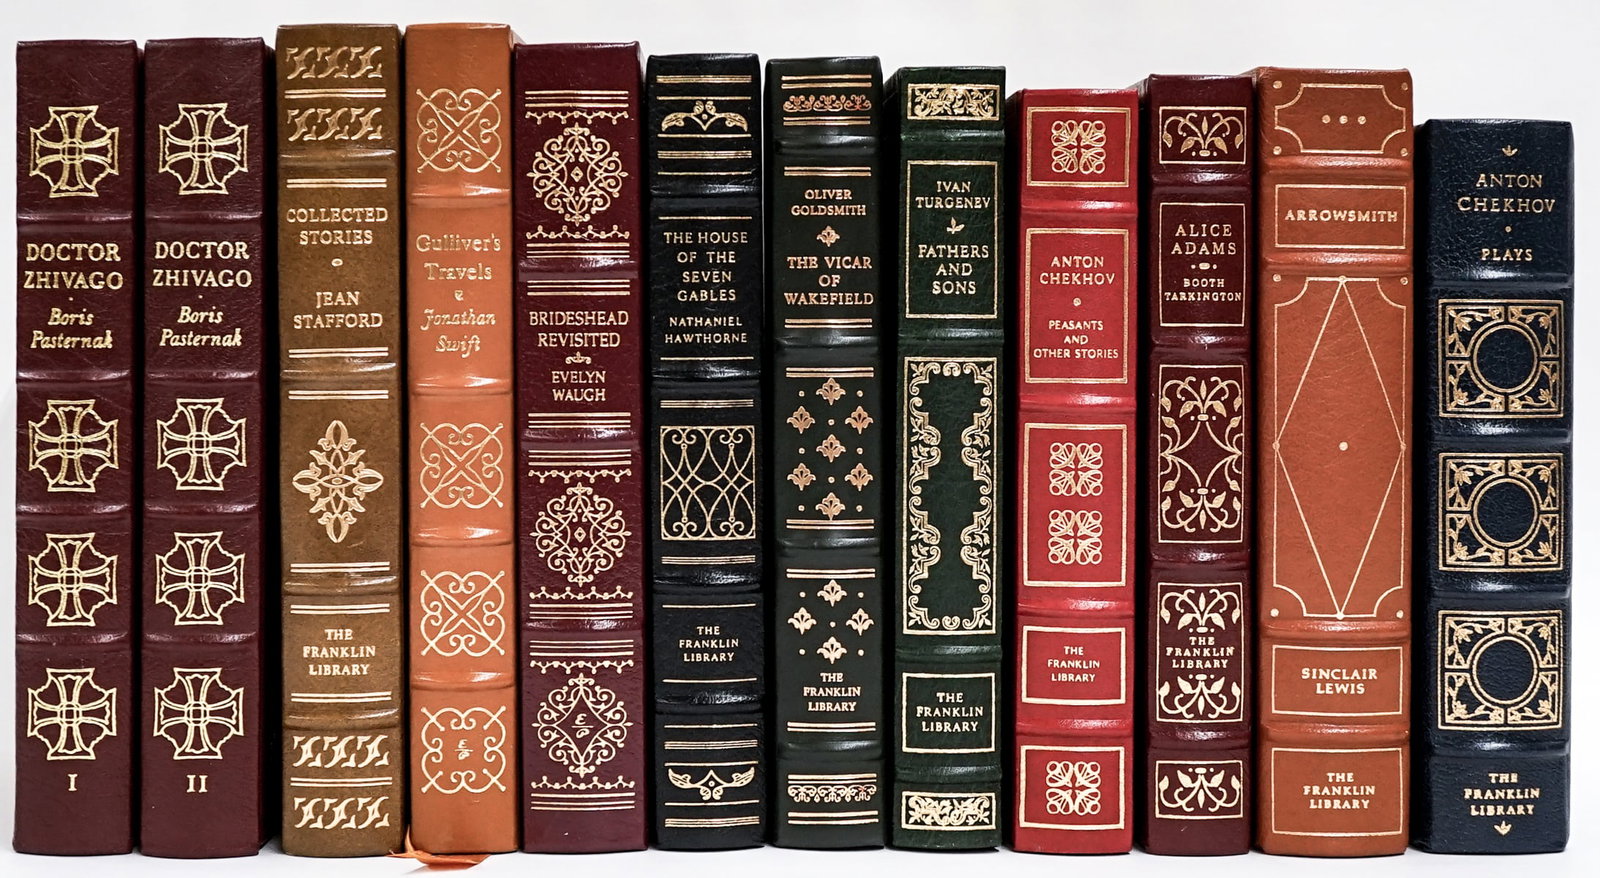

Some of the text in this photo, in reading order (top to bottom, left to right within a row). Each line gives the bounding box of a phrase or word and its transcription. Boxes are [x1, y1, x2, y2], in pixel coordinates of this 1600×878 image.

[937, 181, 970, 192] IVAN
[1476, 174, 1542, 188] ANTON
[805, 189, 852, 199] OLIVER
[916, 197, 990, 208] TURGENEV
[1457, 197, 1555, 213] CHEKHOV
[287, 208, 388, 222] COLLECTED
[791, 205, 866, 215] GOLDSMITH
[1285, 210, 1397, 222] ARROWSMITH
[1175, 224, 1231, 236] ALICE
[300, 230, 372, 245] STORIES
[417, 233, 500, 252] Gulliver's
[664, 232, 747, 243] THE HOUSE
[26, 243, 121, 261] DOCTOR
[155, 241, 249, 259] DOCTOR
[918, 245, 988, 258] FATHERS
[1171, 242, 1236, 255] ADAMS
[677, 251, 735, 263] OF THE
[1482, 249, 1532, 261] PLAYS
[787, 256, 872, 269] THE VICAR
[1051, 256, 1103, 268] ANTON
[424, 263, 491, 280] Travels
[936, 263, 972, 276] AND
[24, 271, 123, 289] ZHIVAGO
[153, 269, 252, 287] ZHIVAGO
[683, 271, 731, 282] SEVEN
[819, 275, 840, 287] OF
[1040, 273, 1114, 285] CHEKHOV
[932, 281, 975, 294] SONS
[1184, 278, 1224, 287] BOOTH
[316, 291, 359, 308] JEAN
[678, 290, 735, 301] GABLES
[784, 293, 873, 305] WAKEFIELD
[1165, 292, 1241, 301] TARKINGTON
[48, 308, 94, 325] Boris
[178, 306, 223, 323] Boris
[421, 309, 495, 330] Jonathan
[530, 311, 628, 325] BRIDESHEAD
[294, 313, 382, 329] STAFFORD
[670, 317, 742, 326] NATHANIEL
[1049, 320, 1103, 330] PEASANTS
[31, 330, 112, 348] Pasternak
[160, 328, 242, 346] Pasternak
[538, 333, 620, 347] REVISITED
[665, 333, 747, 343] HAWTHORNE
[1064, 335, 1088, 345] AND
[436, 335, 480, 358] Swift
[1034, 349, 1118, 358] OTHER STORIES
[552, 371, 606, 383] EVELYN
[553, 388, 605, 401] WAUGH
[325, 629, 353, 640] THE
[697, 626, 719, 635] THE
[680, 639, 738, 648] FRANKLIN
[1189, 637, 1214, 645] THE
[303, 646, 375, 658] FRANKLIN
[1064, 646, 1083, 655] THE
[1166, 647, 1234, 656] FRANKLIN
[684, 653, 734, 661] LIBRARY
[309, 664, 369, 675] LIBRARY
[1048, 659, 1099, 669] FRANKLIN
[1173, 659, 1228, 669] LIBRARY
[820, 673, 843, 682] THE
[1052, 673, 1095, 682] LIBRARY
[1302, 668, 1377, 679] SINCLAIR
[804, 687, 861, 696] FRANKLIN
[1316, 683, 1364, 694] LEWIS
[937, 693, 963, 702] THE
[808, 702, 856, 711] LIBRARY
[917, 706, 983, 717] FRANKLIN
[922, 721, 978, 732] LIBRARY
[68, 774, 77, 791] I
[1327, 773, 1354, 782] THE
[1489, 773, 1517, 783] THE
[187, 775, 207, 792] II
[1304, 786, 1375, 795] FRANKLIN
[1464, 788, 1539, 799] FRANKLIN
[1310, 799, 1369, 809] LIBRARY
[1471, 805, 1534, 816] LIBRARY
